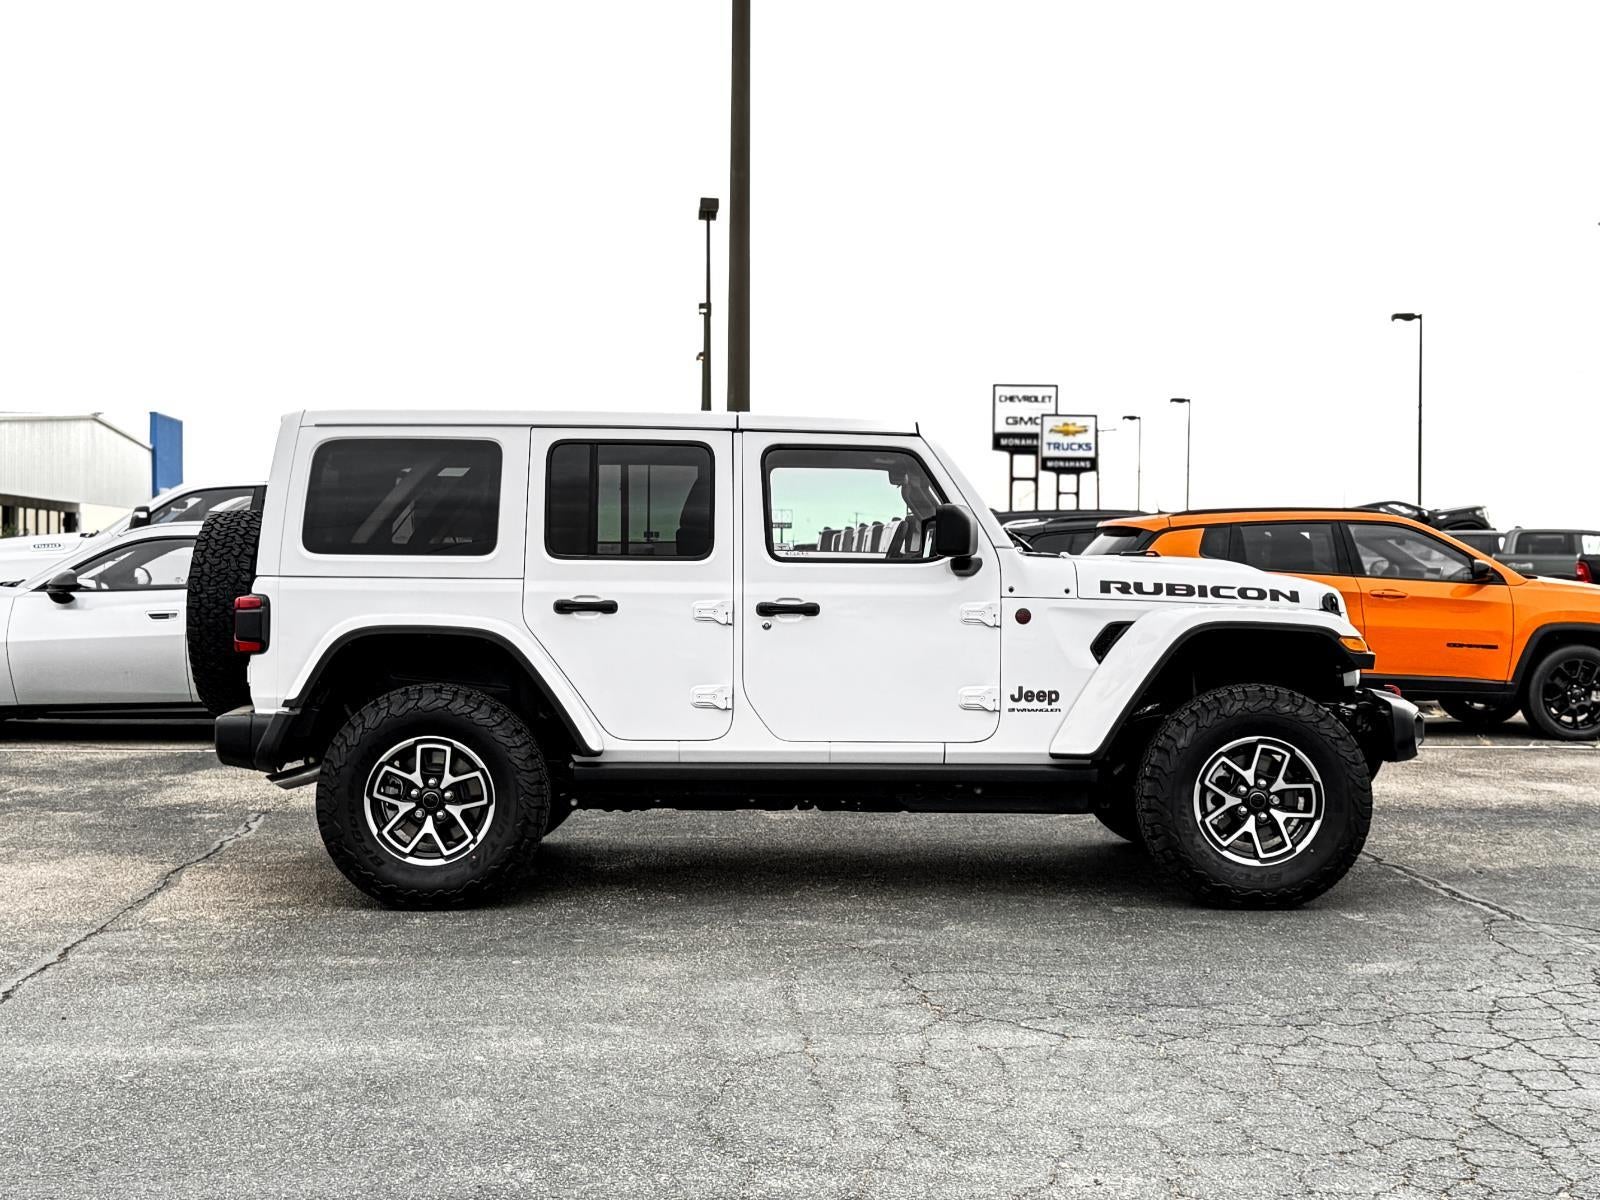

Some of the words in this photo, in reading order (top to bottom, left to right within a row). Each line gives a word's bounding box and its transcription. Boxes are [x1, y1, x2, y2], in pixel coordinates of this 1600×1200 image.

[999, 394, 1052, 403] CHEVROLET
[1005, 416, 1041, 426] GMC
[1001, 438, 1039, 446] MONAHA
[1046, 442, 1092, 452] TRUCKS
[1100, 580, 1300, 603] RUBICON
[1010, 686, 1060, 706] Jeep
